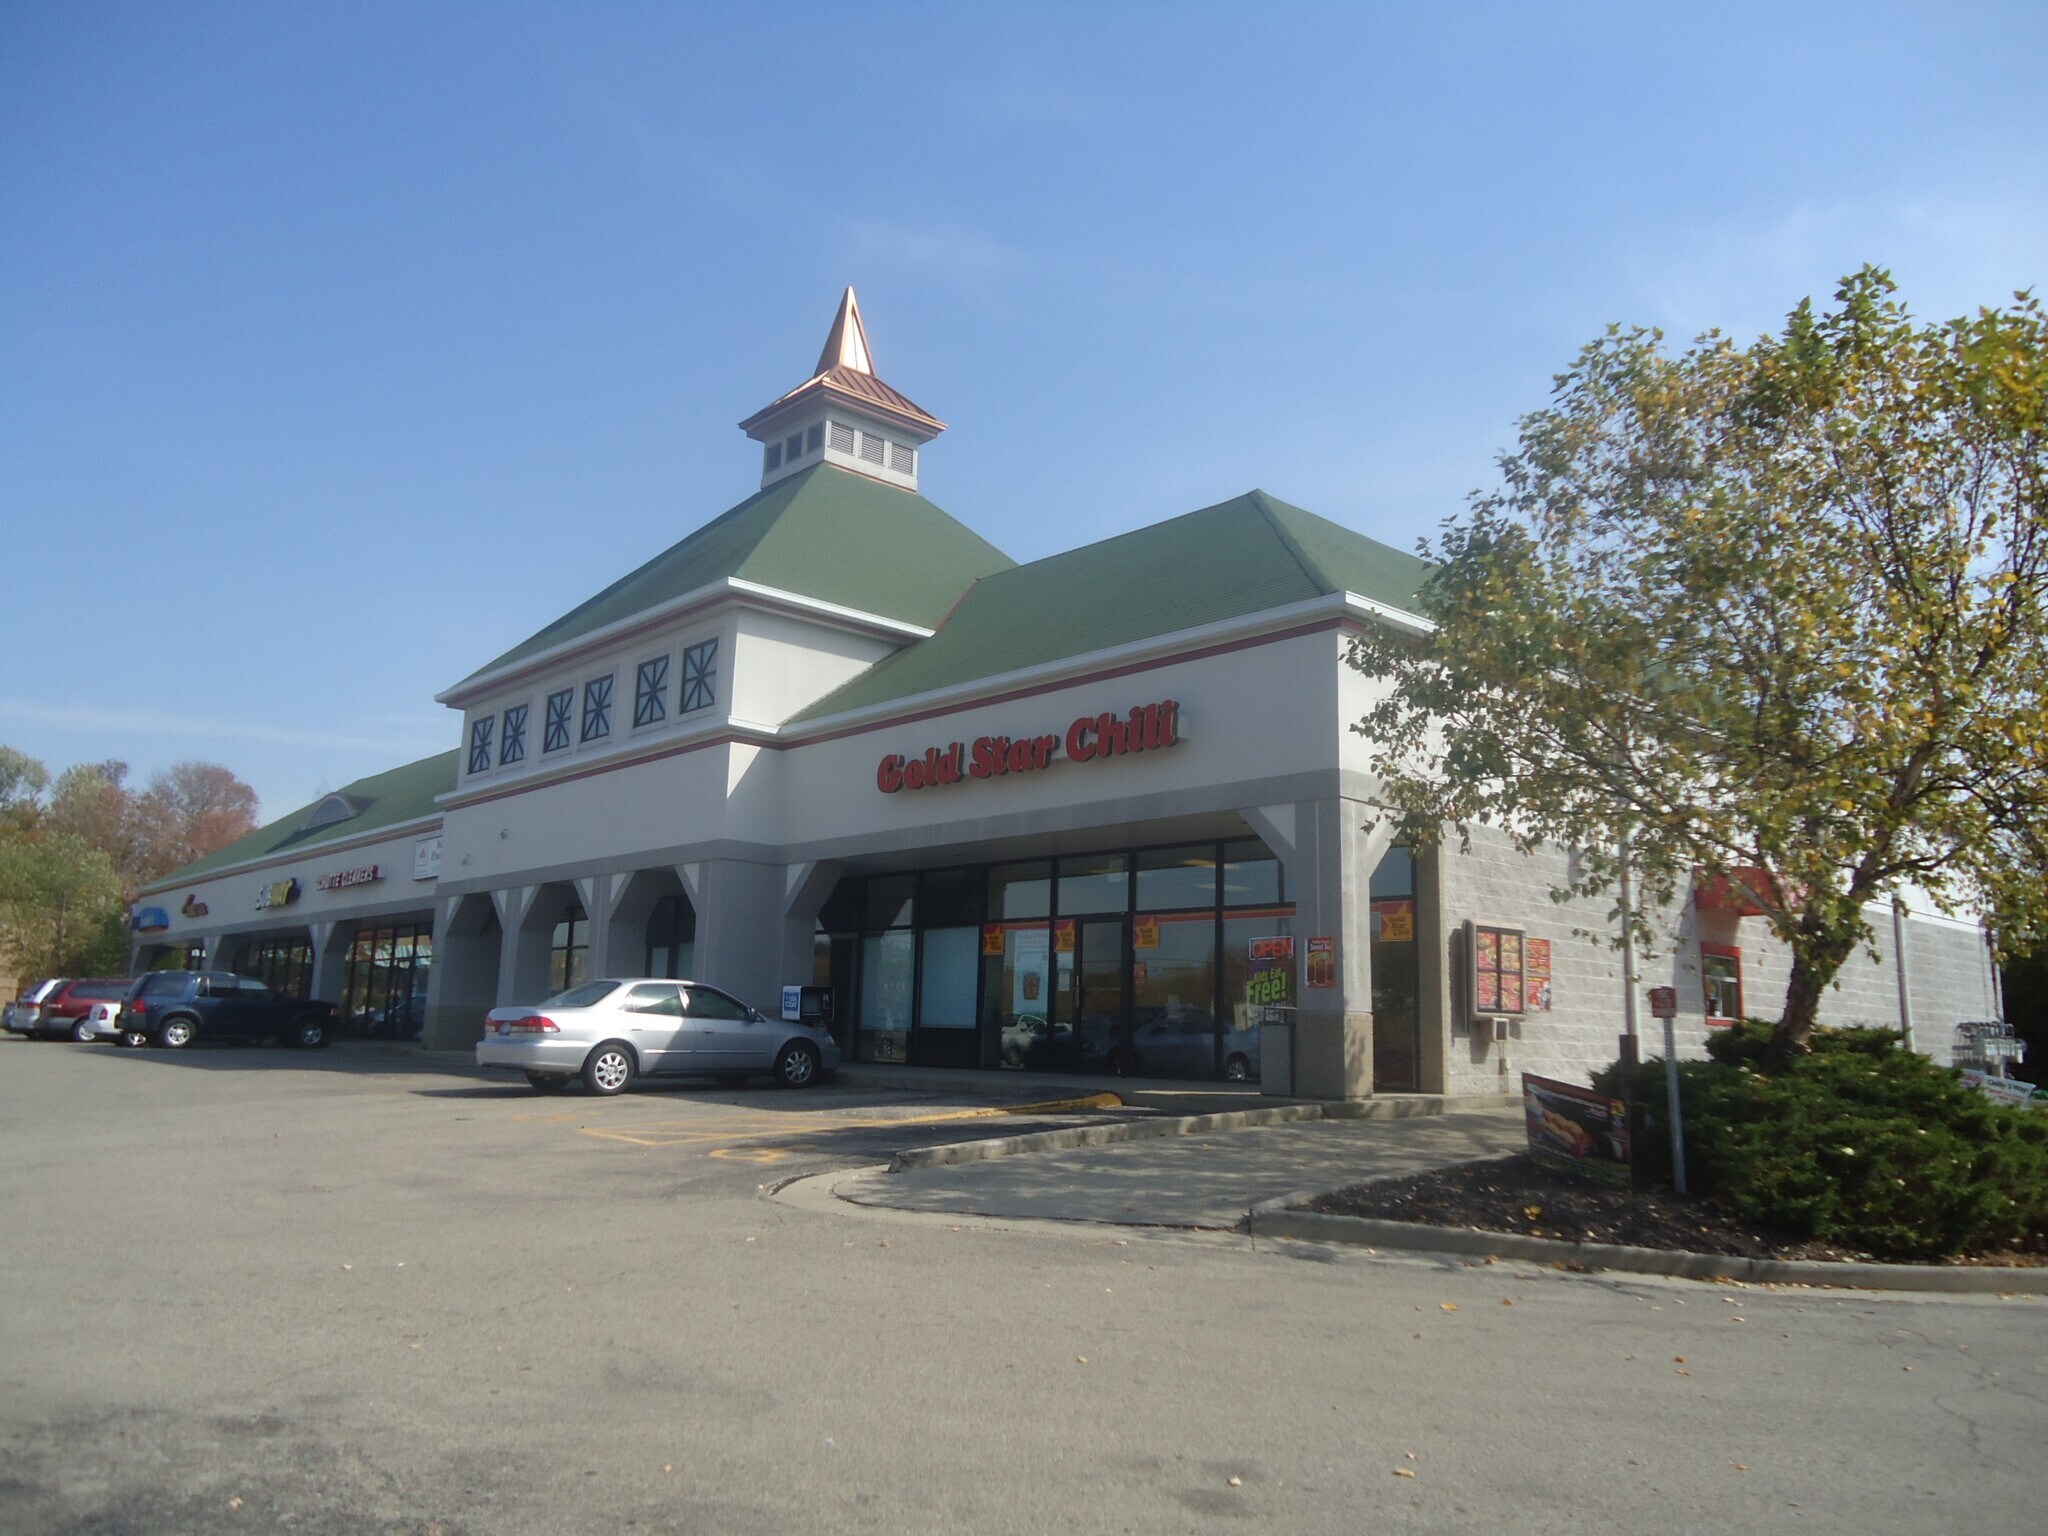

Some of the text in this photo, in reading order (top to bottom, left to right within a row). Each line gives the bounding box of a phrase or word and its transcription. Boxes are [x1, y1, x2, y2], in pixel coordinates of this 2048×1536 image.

[877, 699, 1181, 794] Gold Star Chili
[1253, 938, 1291, 958] OPEN
[1246, 971, 1287, 1007] Free!
[1254, 971, 1269, 983] Kids
